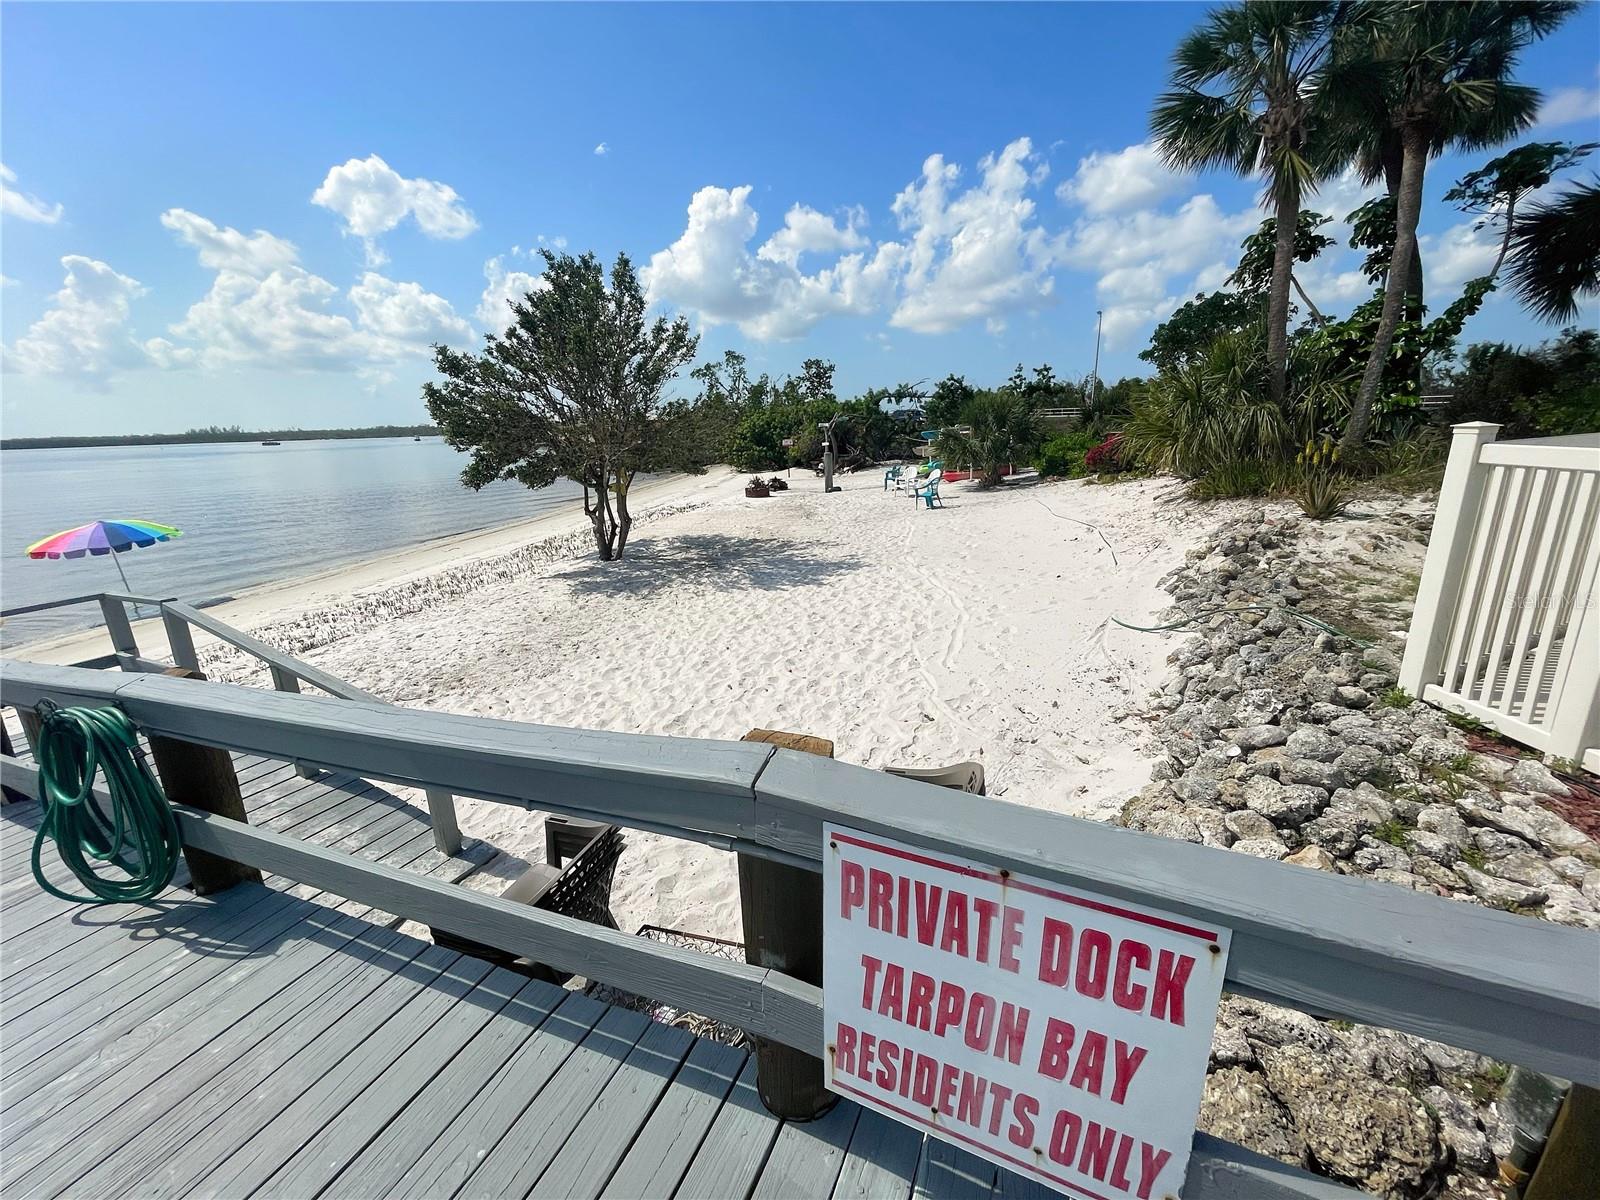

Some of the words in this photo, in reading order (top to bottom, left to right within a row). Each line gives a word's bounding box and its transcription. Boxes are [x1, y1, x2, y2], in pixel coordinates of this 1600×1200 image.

[840, 859, 1024, 973] PRIVATE
[1038, 916, 1196, 1027] DOCK
[835, 1022, 1040, 1149] RESIDENTS
[1049, 1109, 1172, 1200] ONLY
[861, 954, 1030, 1065] TARPON
[1038, 1017, 1148, 1105] BAY
